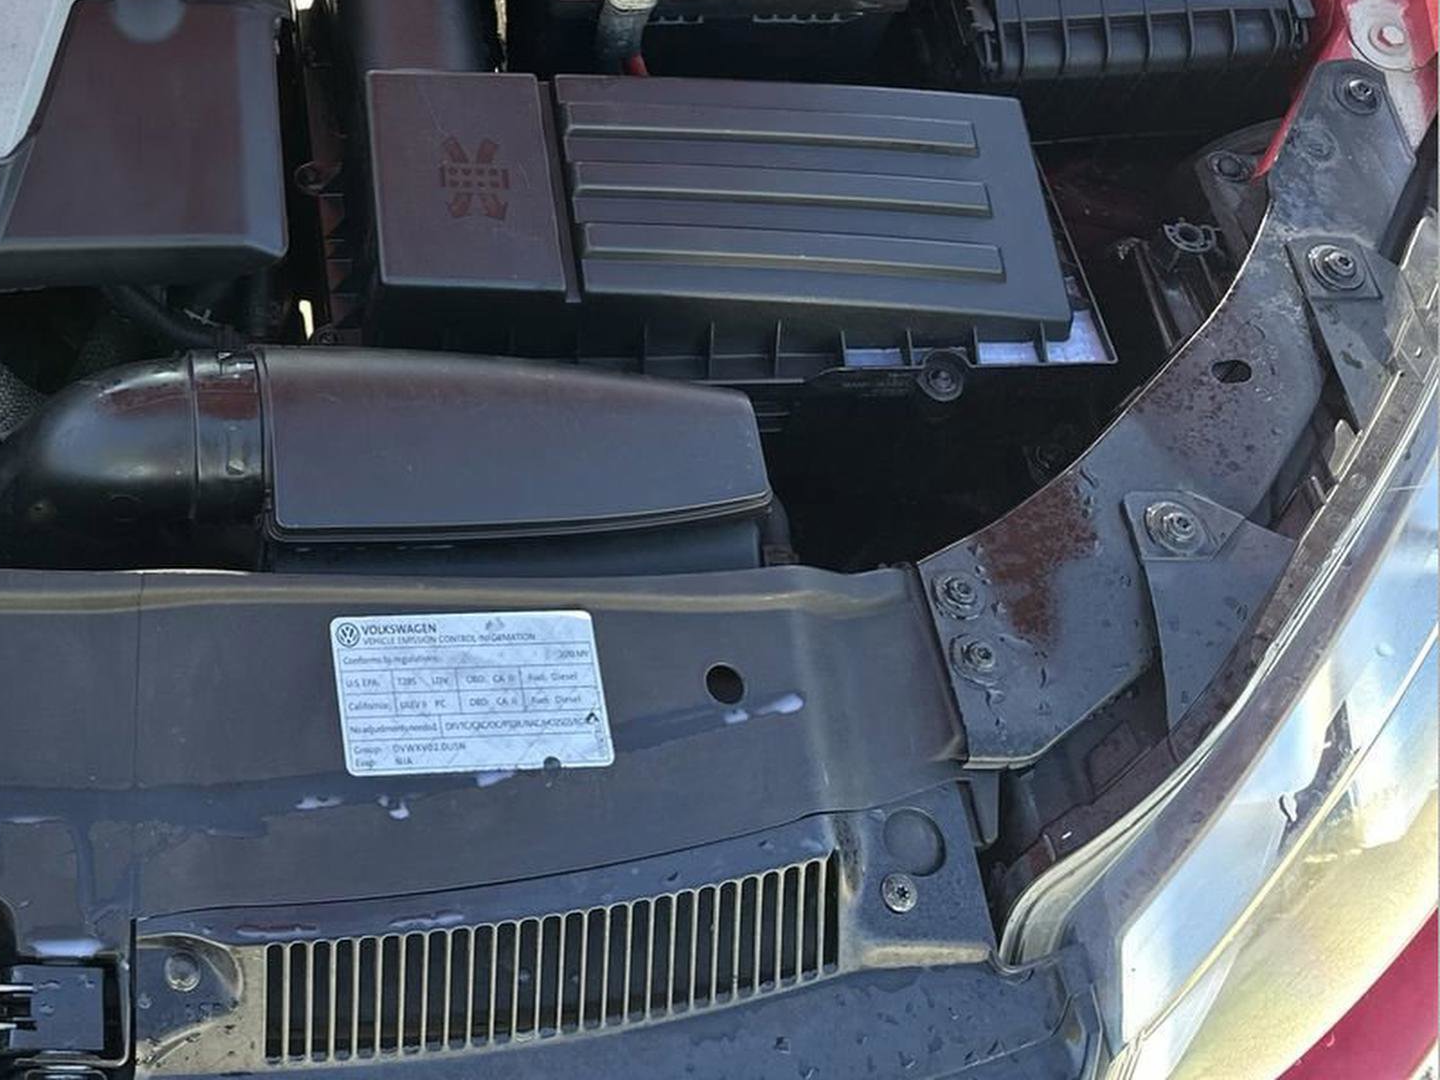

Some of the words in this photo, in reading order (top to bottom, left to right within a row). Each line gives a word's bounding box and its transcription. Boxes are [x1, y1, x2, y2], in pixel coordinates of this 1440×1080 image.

[361, 623, 437, 635] VOLKSWAGEN
[363, 637, 395, 645] VEHICLE
[397, 636, 437, 644] EMISSION
[439, 634, 477, 643] CONTROL
[479, 633, 536, 642] INFORMATION
